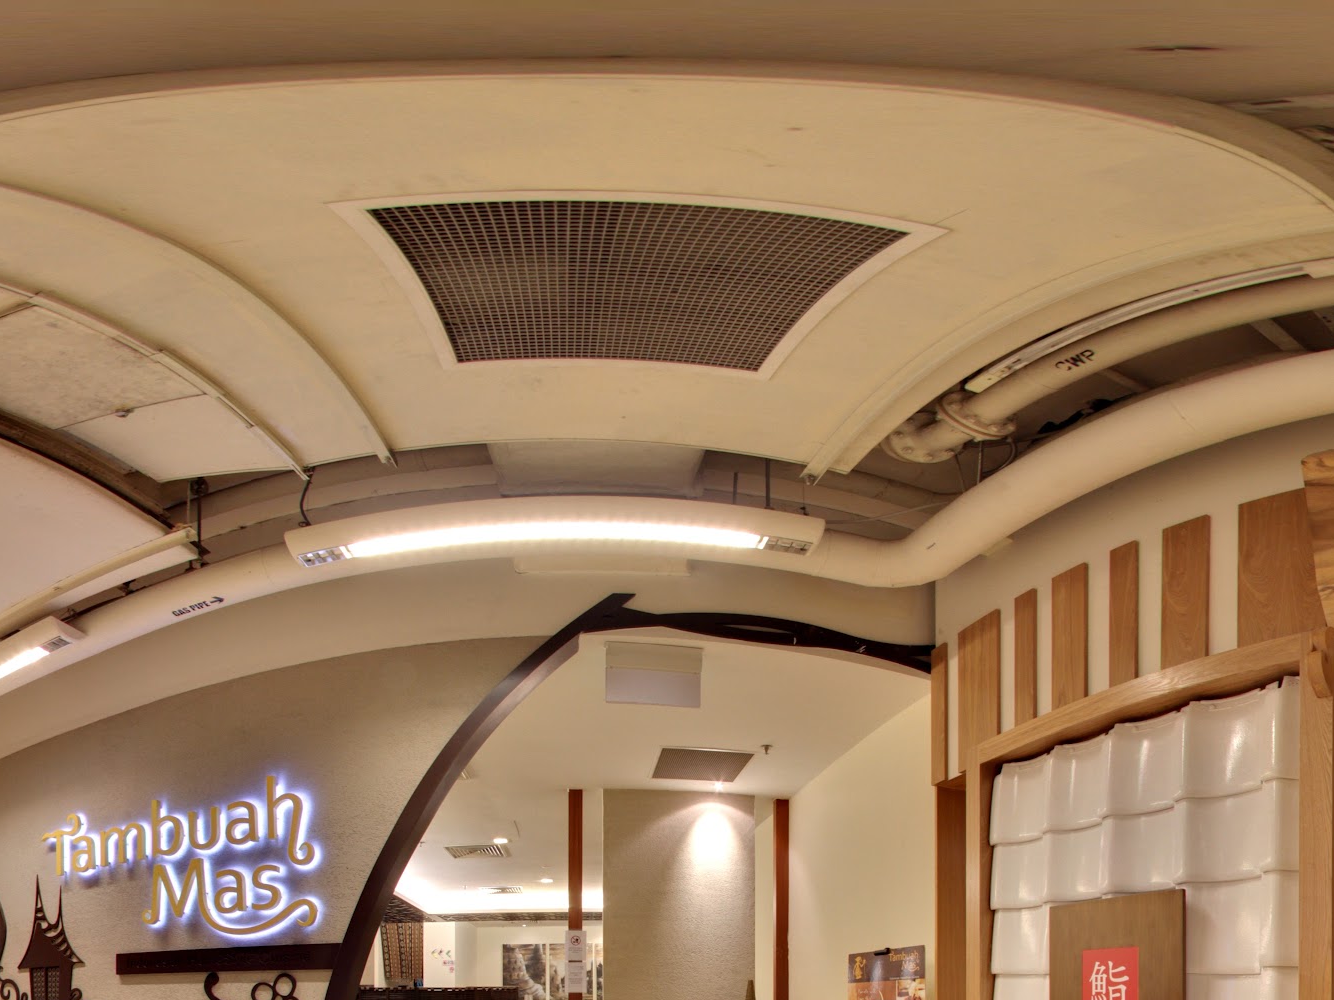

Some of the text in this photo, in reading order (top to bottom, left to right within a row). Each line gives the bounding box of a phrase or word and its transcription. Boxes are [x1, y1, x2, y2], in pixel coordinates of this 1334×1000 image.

[171, 600, 211, 617] GAS PIPE
[40, 774, 316, 877] Tambuah
[142, 857, 318, 936] Mas
